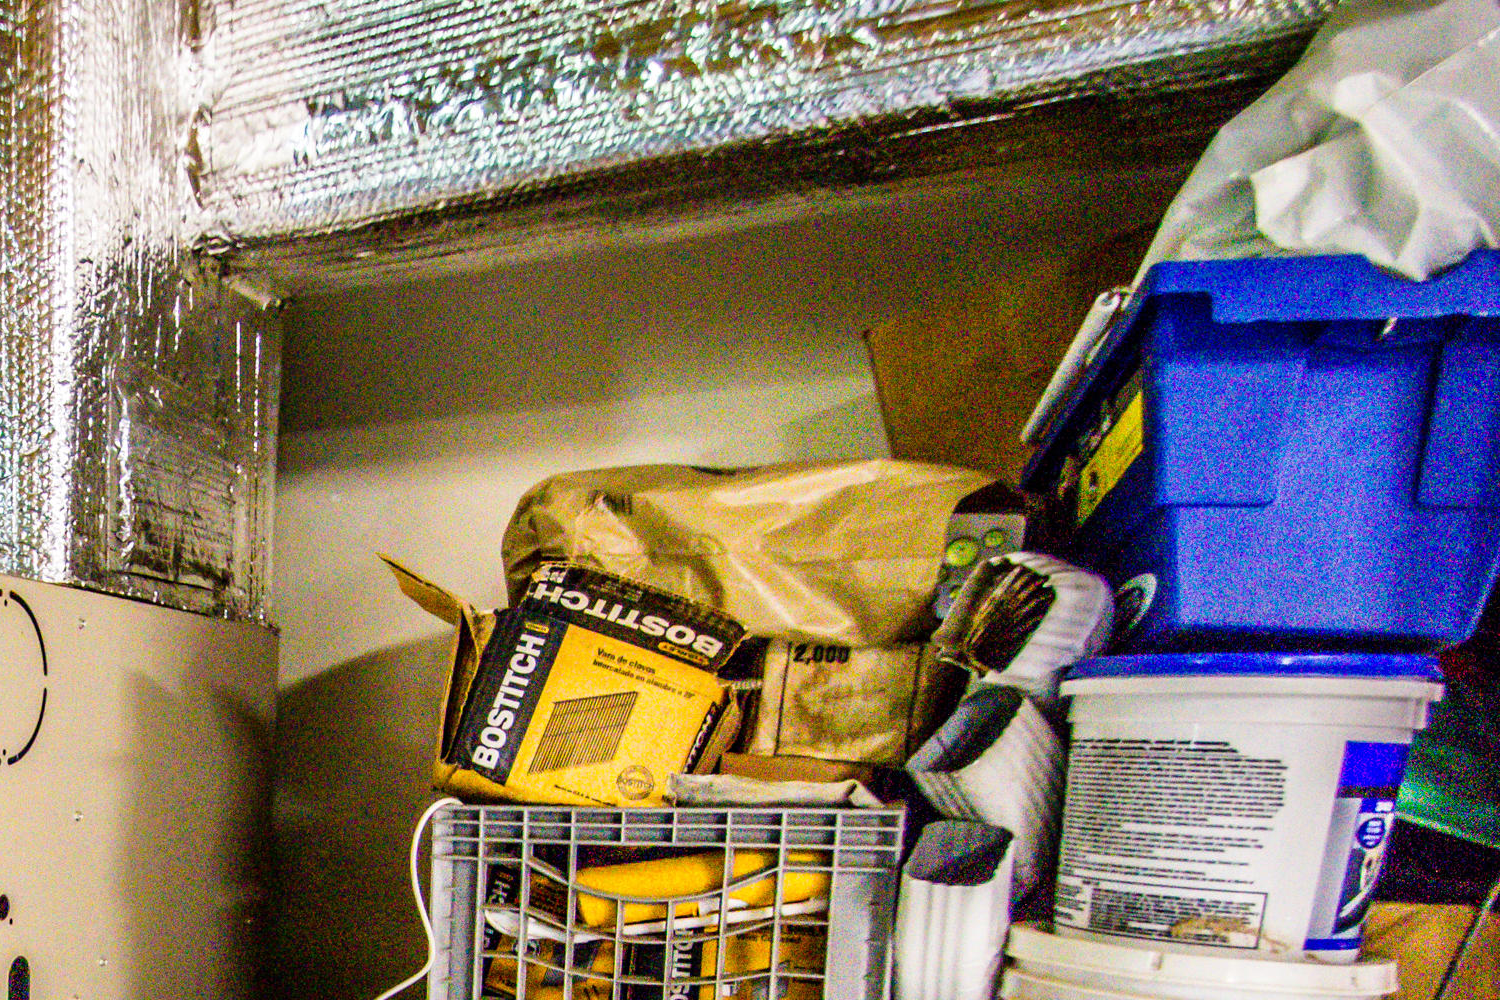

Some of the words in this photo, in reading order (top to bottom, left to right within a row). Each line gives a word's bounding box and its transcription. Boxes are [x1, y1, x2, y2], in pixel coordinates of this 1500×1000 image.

[533, 582, 723, 658] BOSTITCH
[793, 643, 852, 665] 2,000
[472, 633, 546, 770] BOSTITCH
